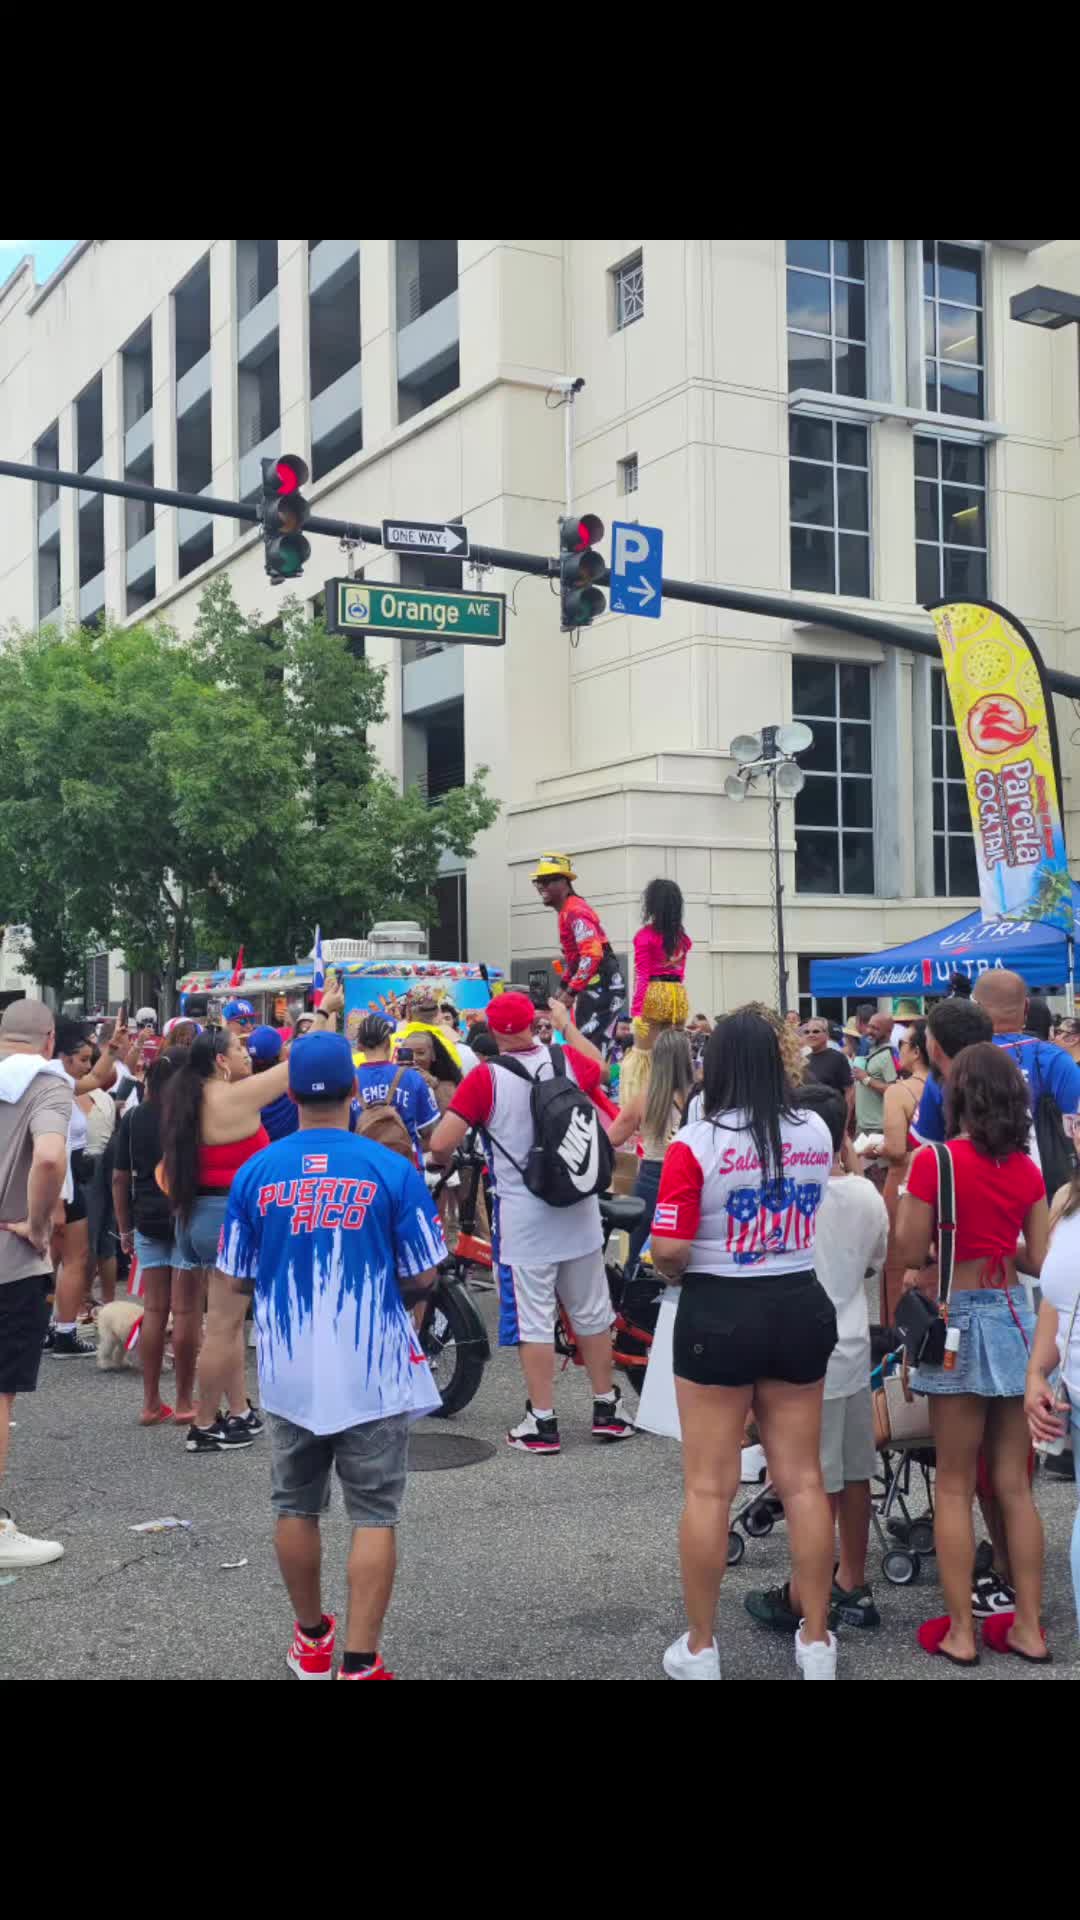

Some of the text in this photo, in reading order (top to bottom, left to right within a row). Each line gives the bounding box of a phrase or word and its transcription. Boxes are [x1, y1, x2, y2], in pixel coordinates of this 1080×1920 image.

[392, 529, 442, 545] ONE WAY
[615, 528, 649, 576] P
[381, 594, 490, 630] Orange AVE
[939, 920, 1031, 946] ULTRA
[855, 965, 918, 988] Michelob
[557, 1106, 592, 1173] NIKE
[257, 1177, 378, 1217] PUERTO
[291, 1202, 367, 1236] RICO
